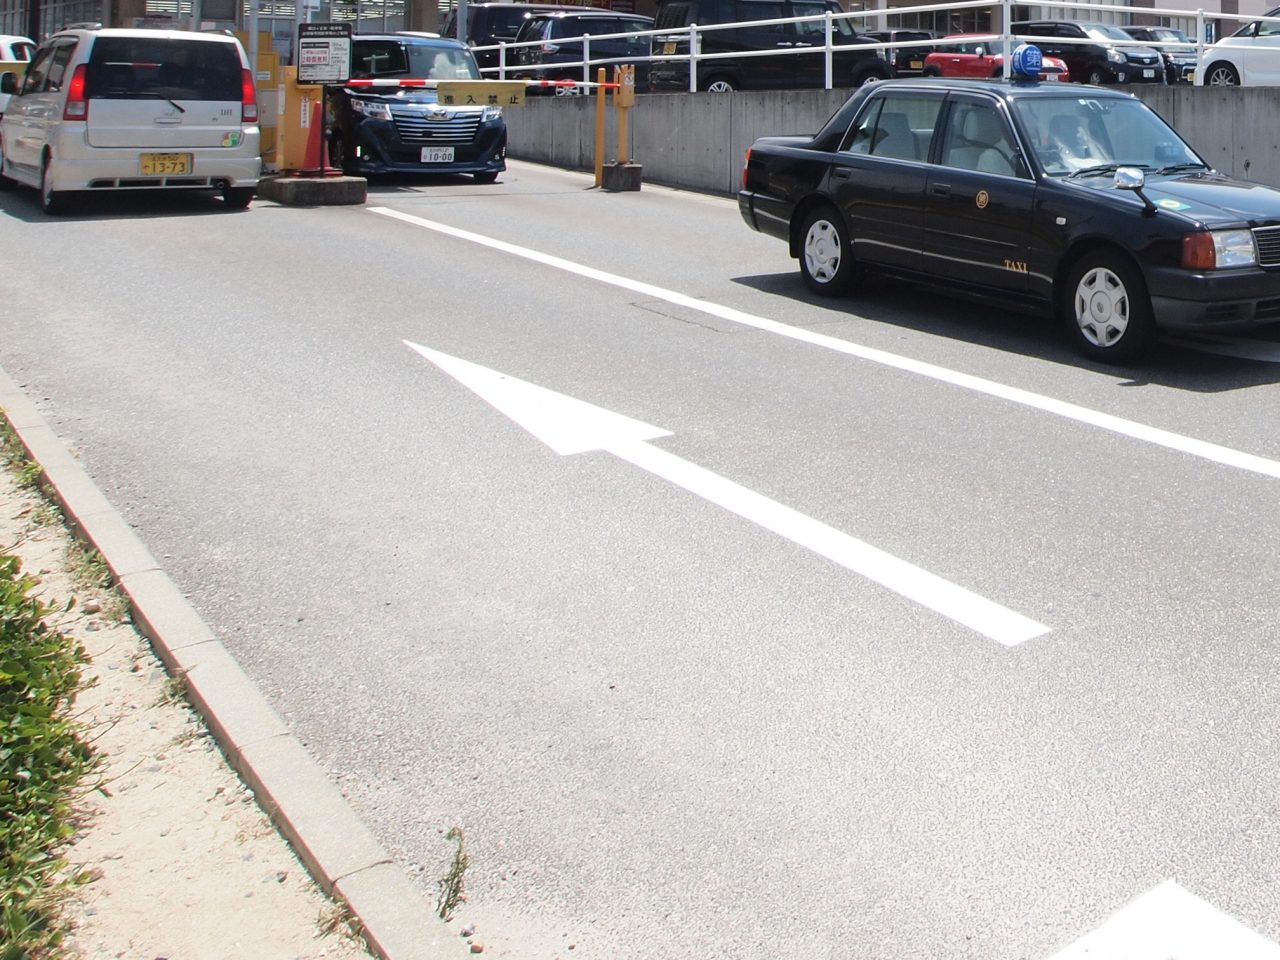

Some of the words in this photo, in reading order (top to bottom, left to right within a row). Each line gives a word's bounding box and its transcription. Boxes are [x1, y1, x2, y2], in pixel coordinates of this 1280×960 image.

[444, 95, 519, 105] 進入禁止
[1004, 259, 1028, 273] TAXI
